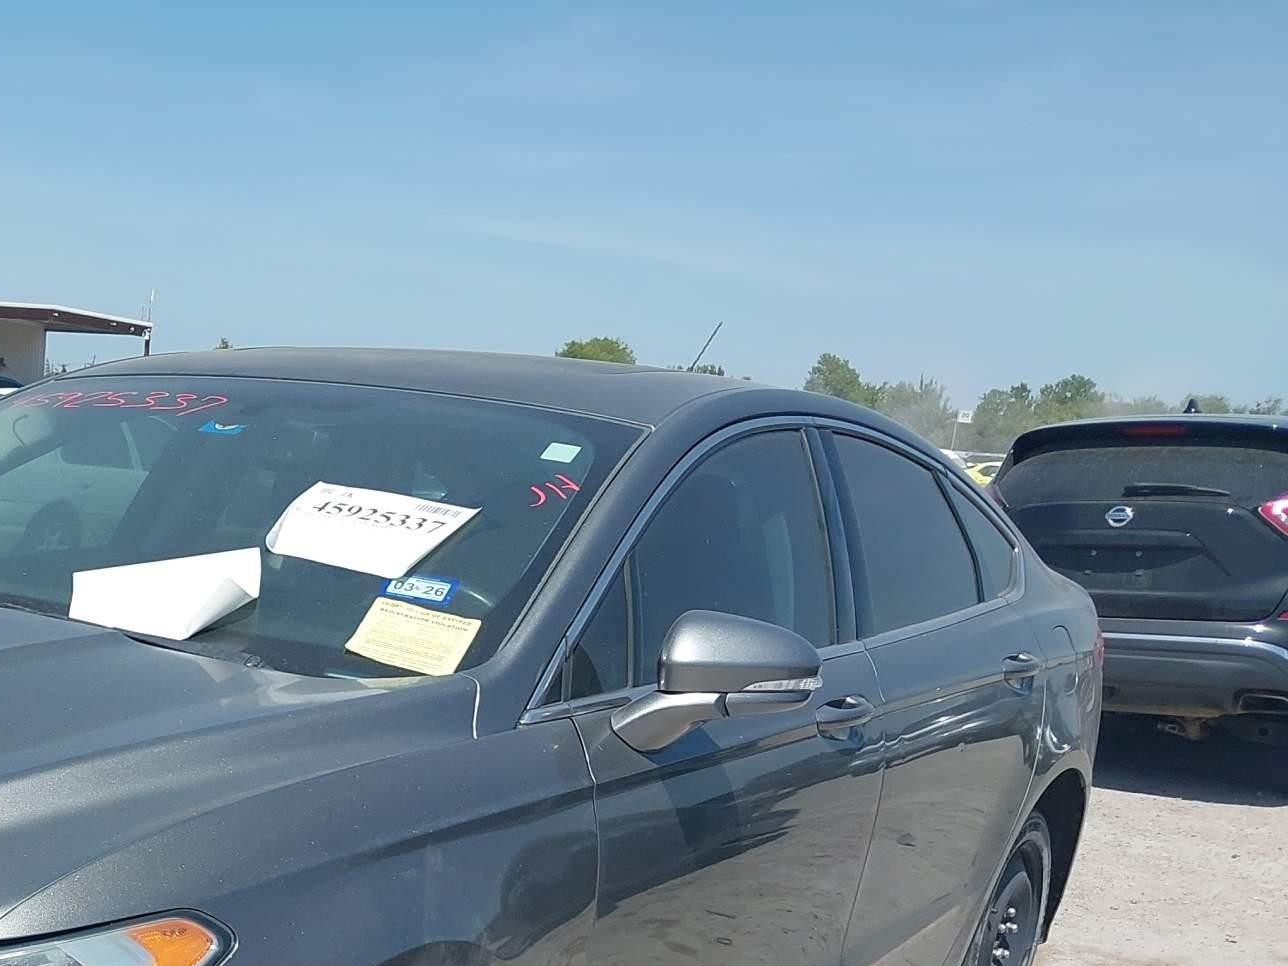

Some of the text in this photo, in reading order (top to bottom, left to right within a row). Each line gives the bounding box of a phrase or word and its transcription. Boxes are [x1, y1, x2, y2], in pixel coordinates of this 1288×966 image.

[312, 500, 448, 534] 45925337
[394, 580, 446, 598] 03 26
